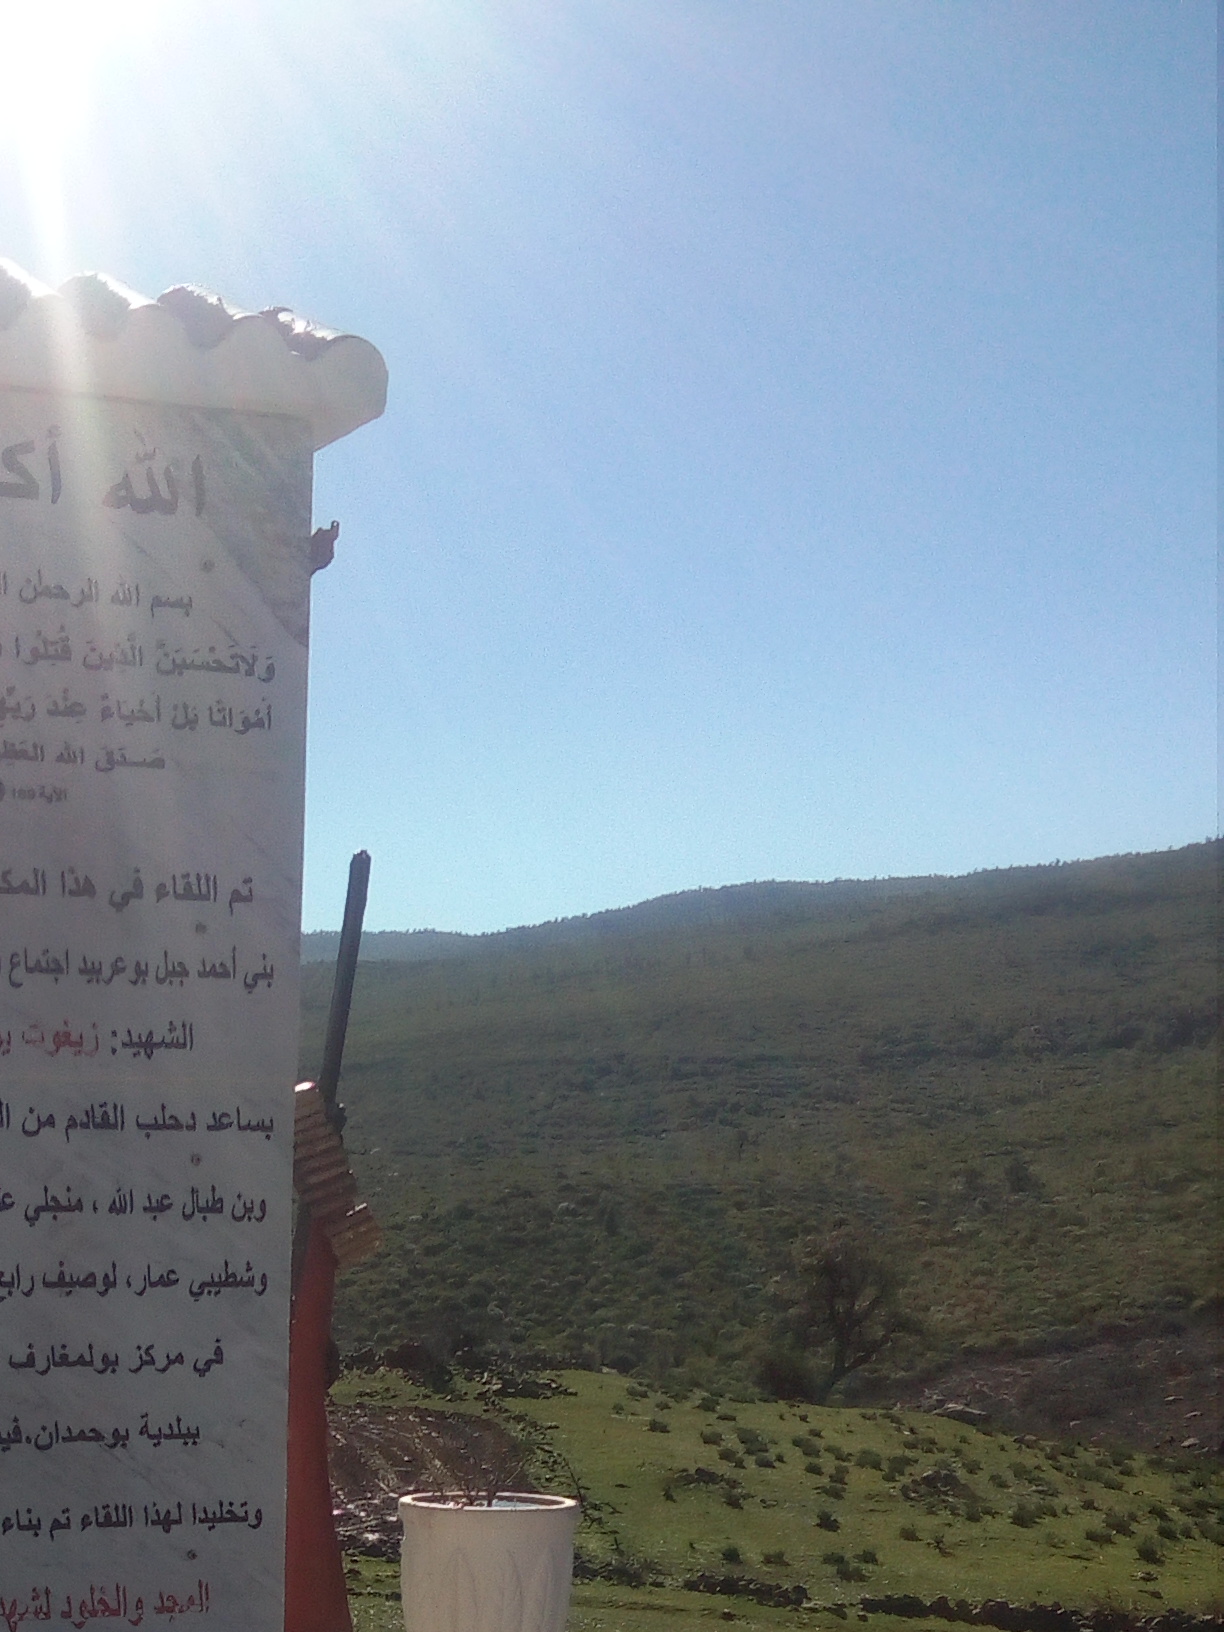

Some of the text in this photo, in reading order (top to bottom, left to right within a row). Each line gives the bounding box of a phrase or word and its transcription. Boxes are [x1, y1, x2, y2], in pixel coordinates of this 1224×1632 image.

[110, 578, 140, 607] الله
[150, 595, 193, 619] بسم
[61, 866, 97, 899] هذا
[108, 866, 145, 913] في
[155, 872, 218, 904] اللقاء
[228, 876, 253, 916] تم
[8, 946, 70, 989] اجتماع
[155, 949, 190, 987] جبل
[196, 944, 237, 980] أحمد
[243, 952, 275, 995] بني
[21, 1106, 57, 1138] من
[64, 1101, 125, 1144] القادم
[136, 1102, 198, 1141] دحلب
[206, 1105, 275, 1142] بساعد
[24, 1184, 84, 1228] منجلي
[107, 1182, 135, 1216] الله
[142, 1192, 175, 1222] عبد
[181, 1183, 225, 1223] طبال
[230, 1191, 268, 1223] وبن
[41, 1259, 119, 1298] لوصيف
[188, 1259, 269, 1303] وشطيبي
[7, 1341, 120, 1377] بولمغارف
[128, 1343, 185, 1374] مركز
[192, 1338, 225, 1378] في
[138, 1411, 201, 1448] ببلدية
[1, 1507, 43, 1539] بناء
[48, 1507, 72, 1542] تم
[79, 1502, 133, 1533] اللقاء
[142, 1501, 183, 1535] لهذا
[188, 1499, 264, 1531] وتخليدا
[153, 1578, 211, 1623] المجد
